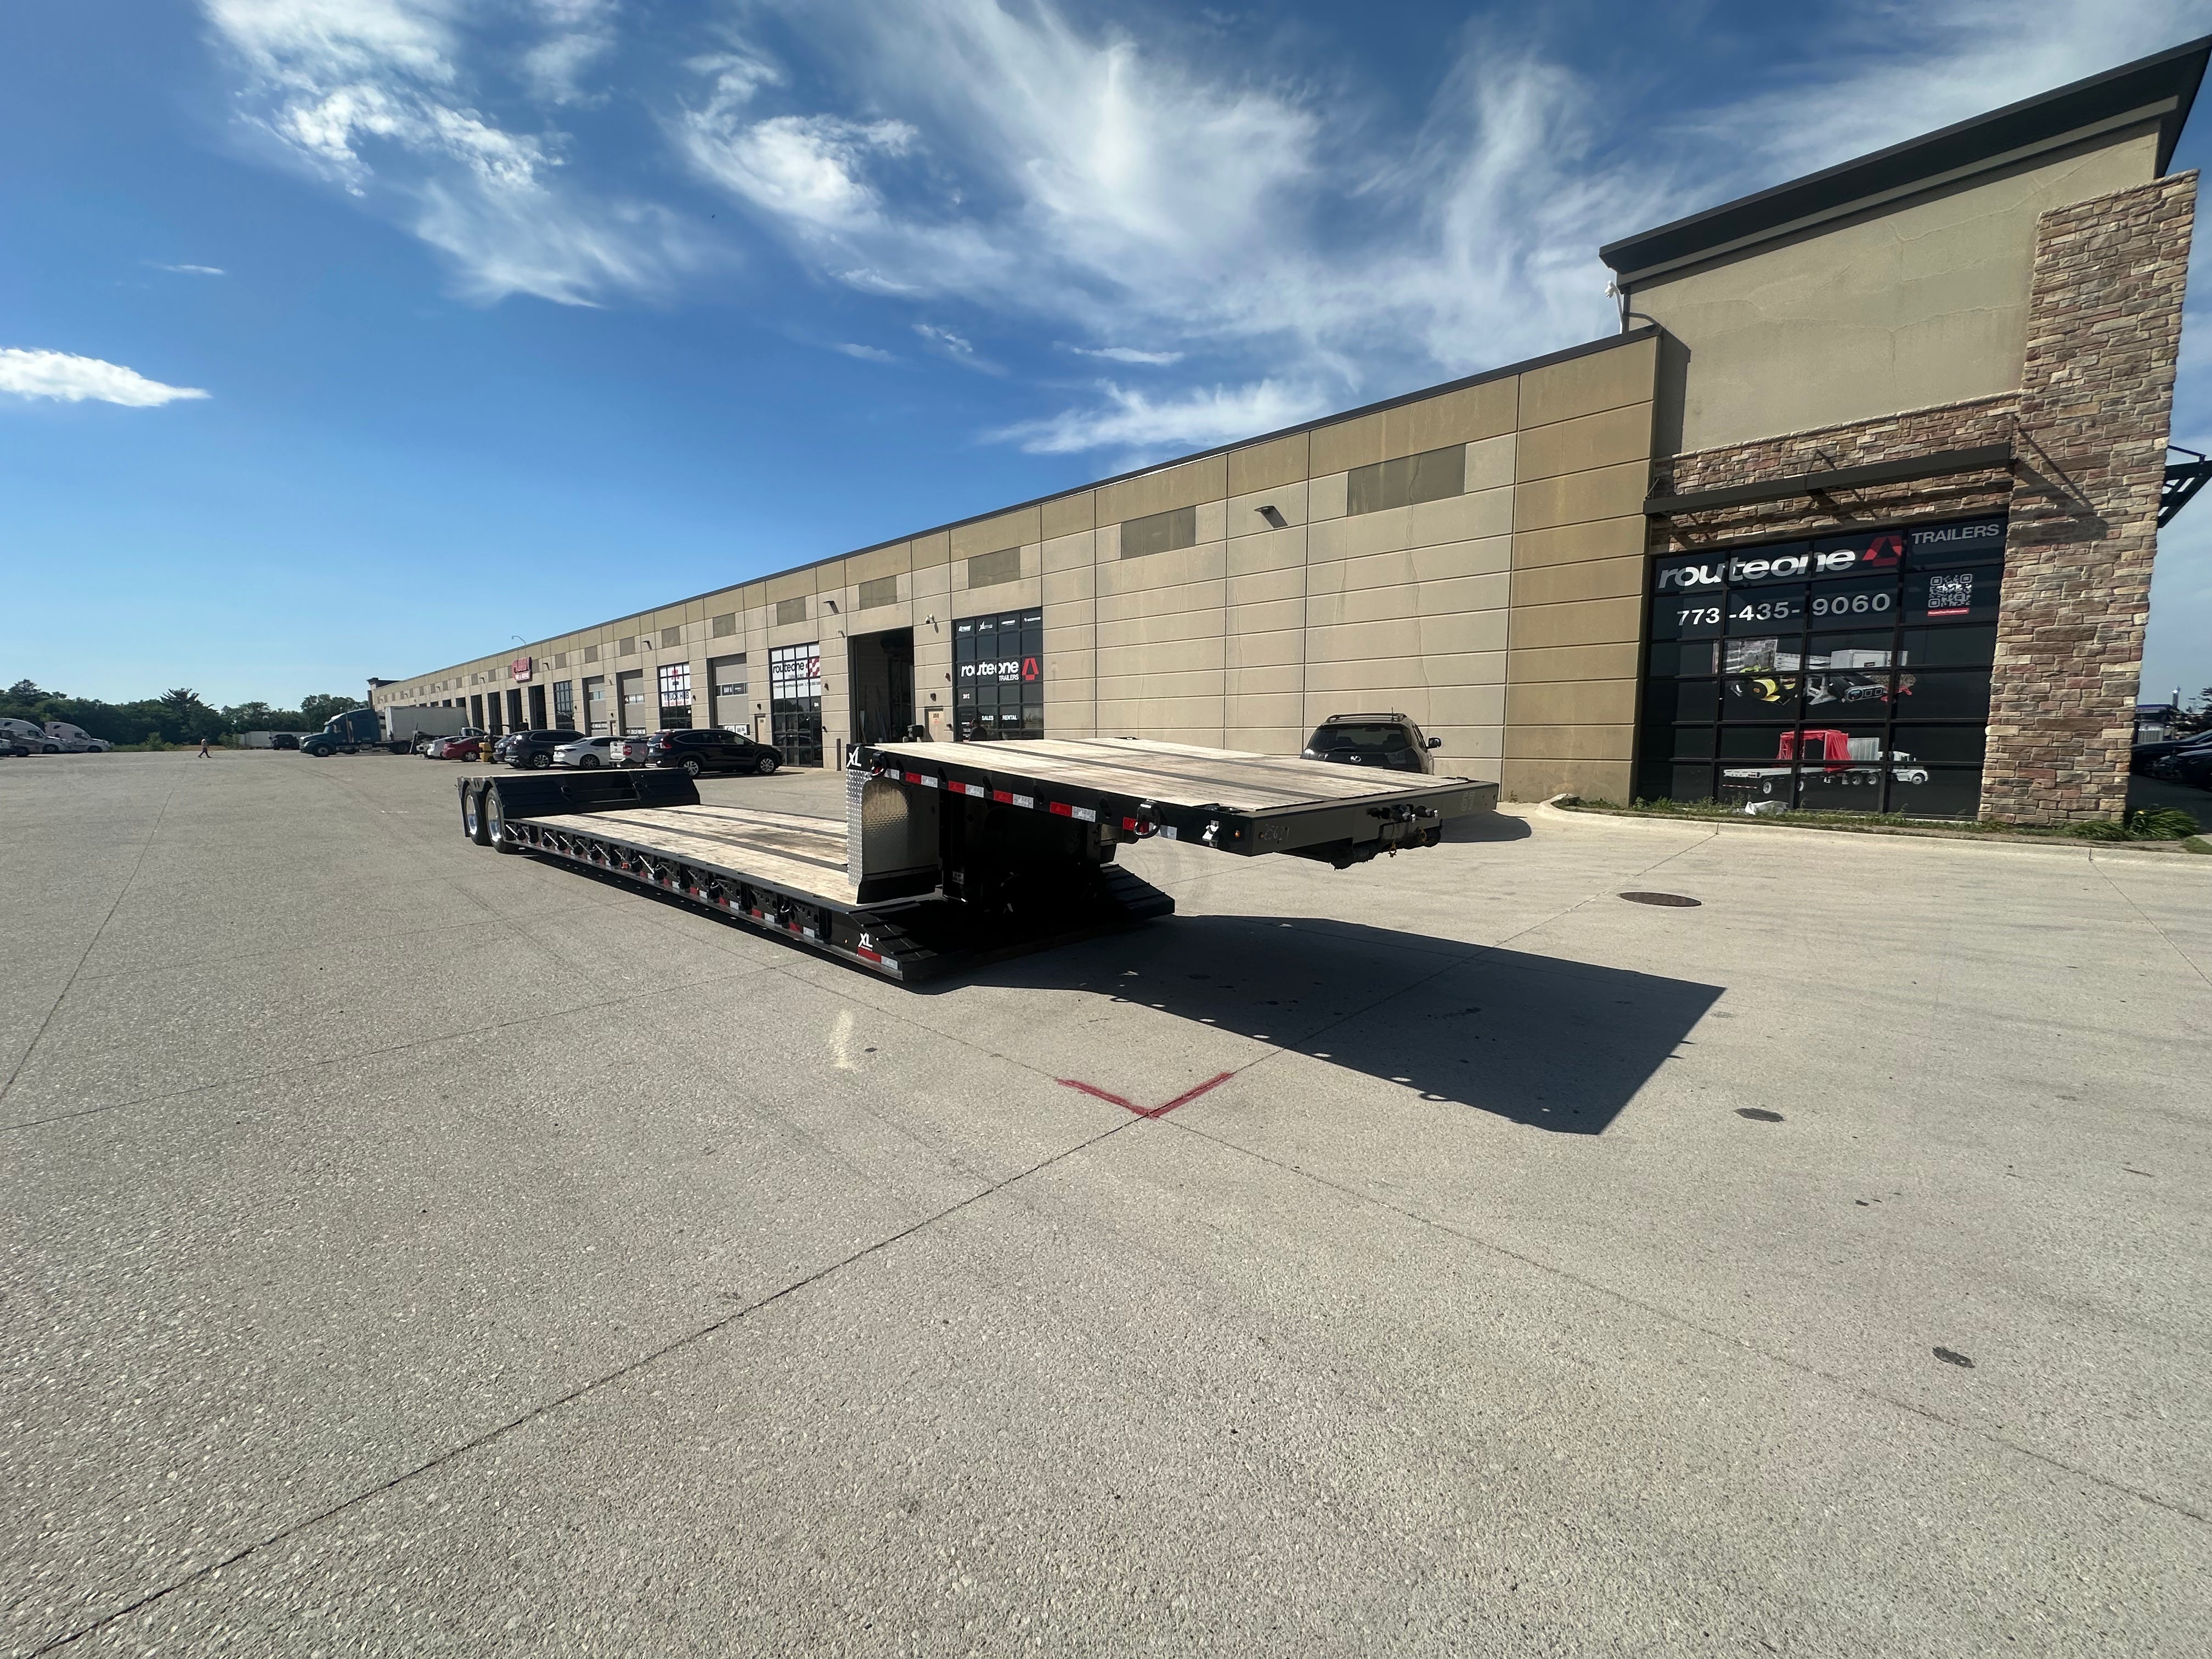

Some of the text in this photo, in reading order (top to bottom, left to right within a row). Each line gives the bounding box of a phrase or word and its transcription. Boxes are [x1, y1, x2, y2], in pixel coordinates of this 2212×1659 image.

[1911, 524, 2000, 544] TRAILERS
[1658, 549, 1856, 589] routeone
[961, 661, 1019, 677] routeone
[680, 691, 690, 700] HB
[846, 746, 862, 768] XL
[857, 932, 873, 947] XL
